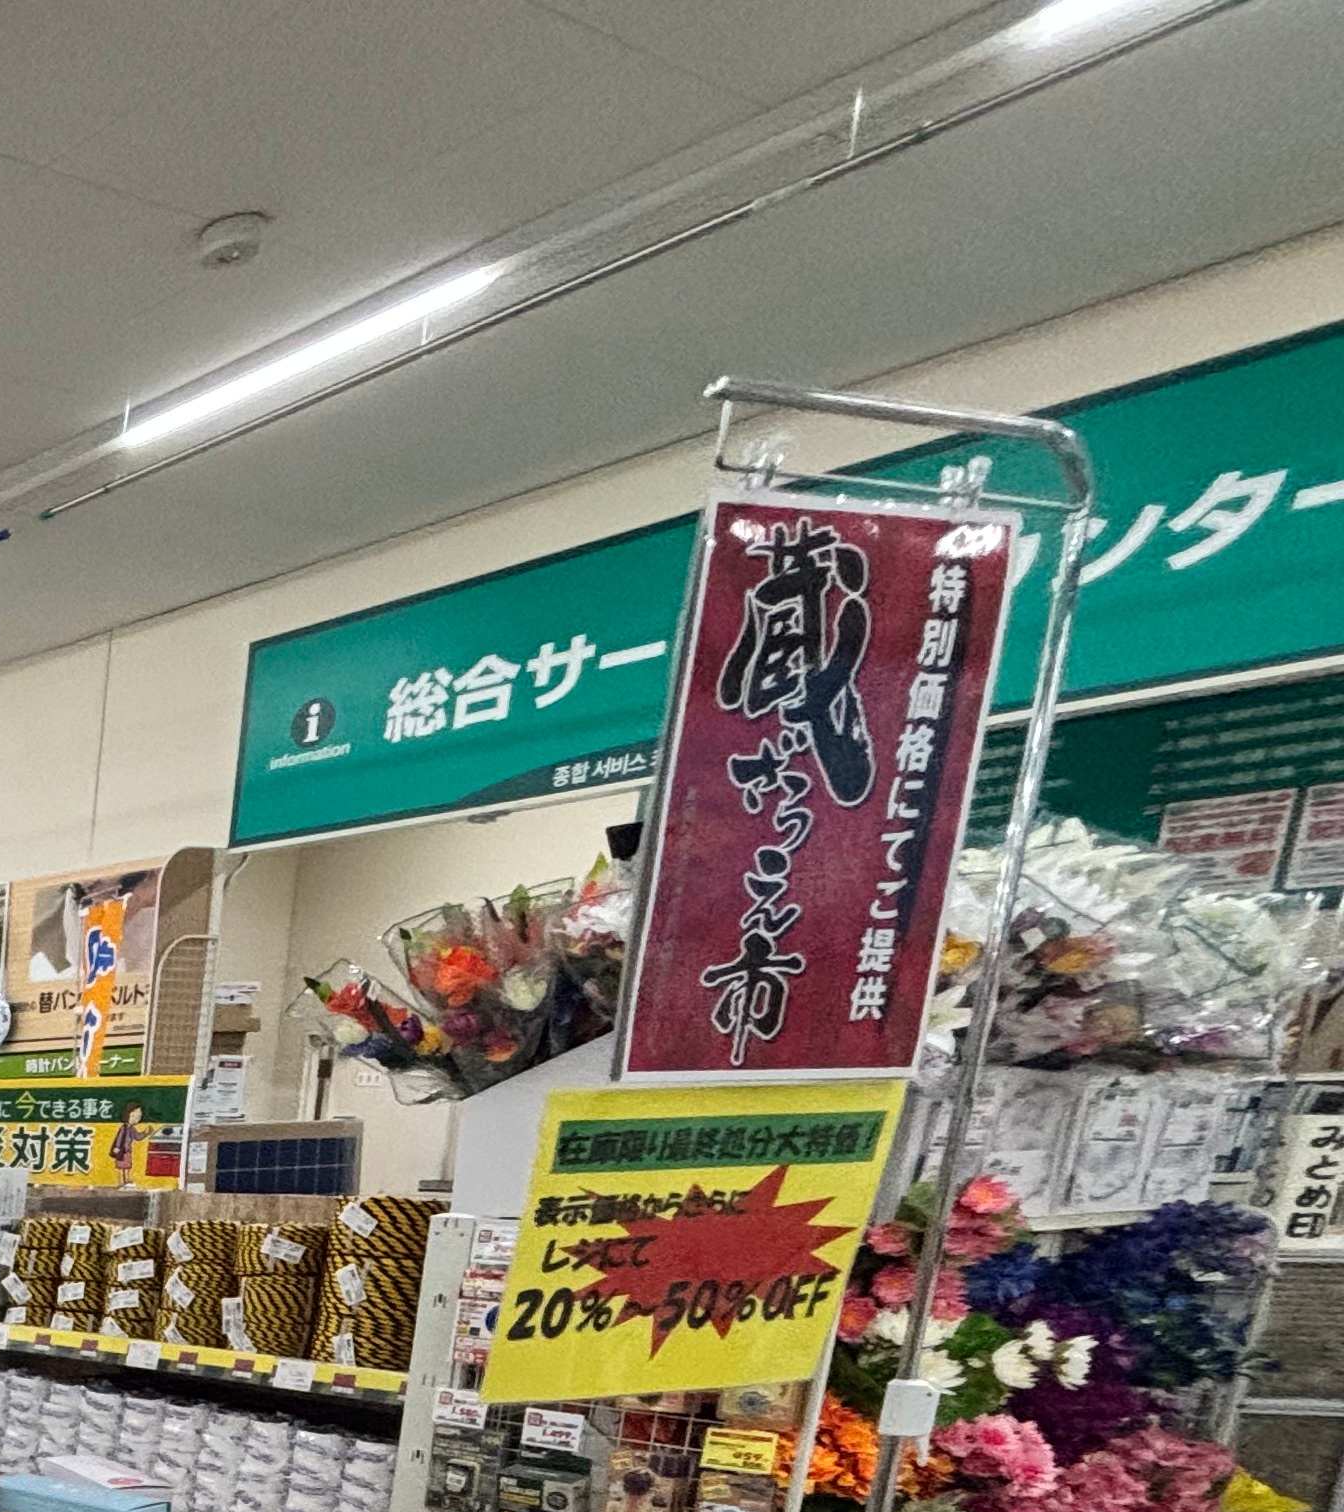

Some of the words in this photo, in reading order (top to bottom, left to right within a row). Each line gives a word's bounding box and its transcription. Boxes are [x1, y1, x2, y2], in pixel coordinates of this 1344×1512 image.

[382, 633, 668, 743] 総合サー
[269, 742, 351, 770] information
[552, 757, 591, 788] 종합
[591, 752, 647, 779] 서비스
[849, 564, 968, 1022] 特別価格にてご提供
[1285, 1125, 1344, 1239] みとめ印
